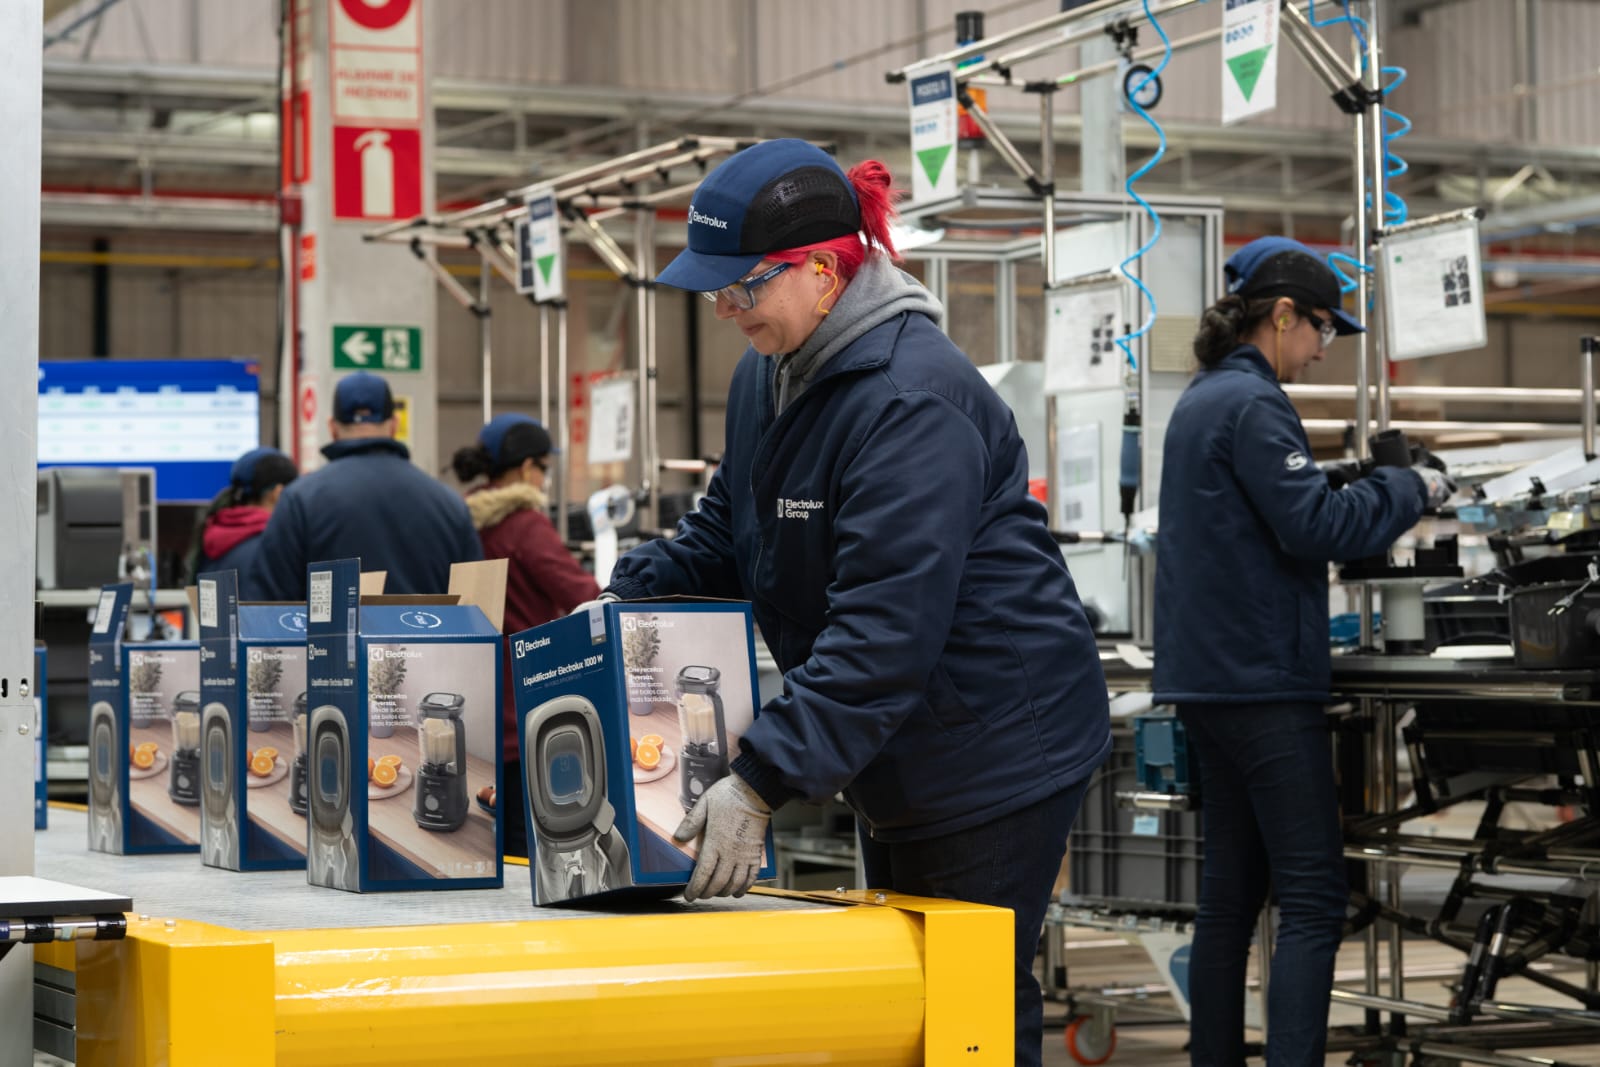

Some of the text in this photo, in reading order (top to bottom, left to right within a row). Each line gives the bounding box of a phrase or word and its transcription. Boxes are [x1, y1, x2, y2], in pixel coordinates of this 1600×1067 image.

[693, 211, 728, 229] Electrolux
[785, 499, 824, 509] Electrolux
[785, 509, 809, 520] Group
[638, 620, 675, 628] Electrolux
[525, 637, 551, 651] Electrolux
[385, 650, 423, 658] Electrolux
[523, 670, 557, 687] Liquidificador
[558, 662, 583, 675] Electrolux
[583, 656, 597, 668] 1000
[596, 653, 604, 664] W
